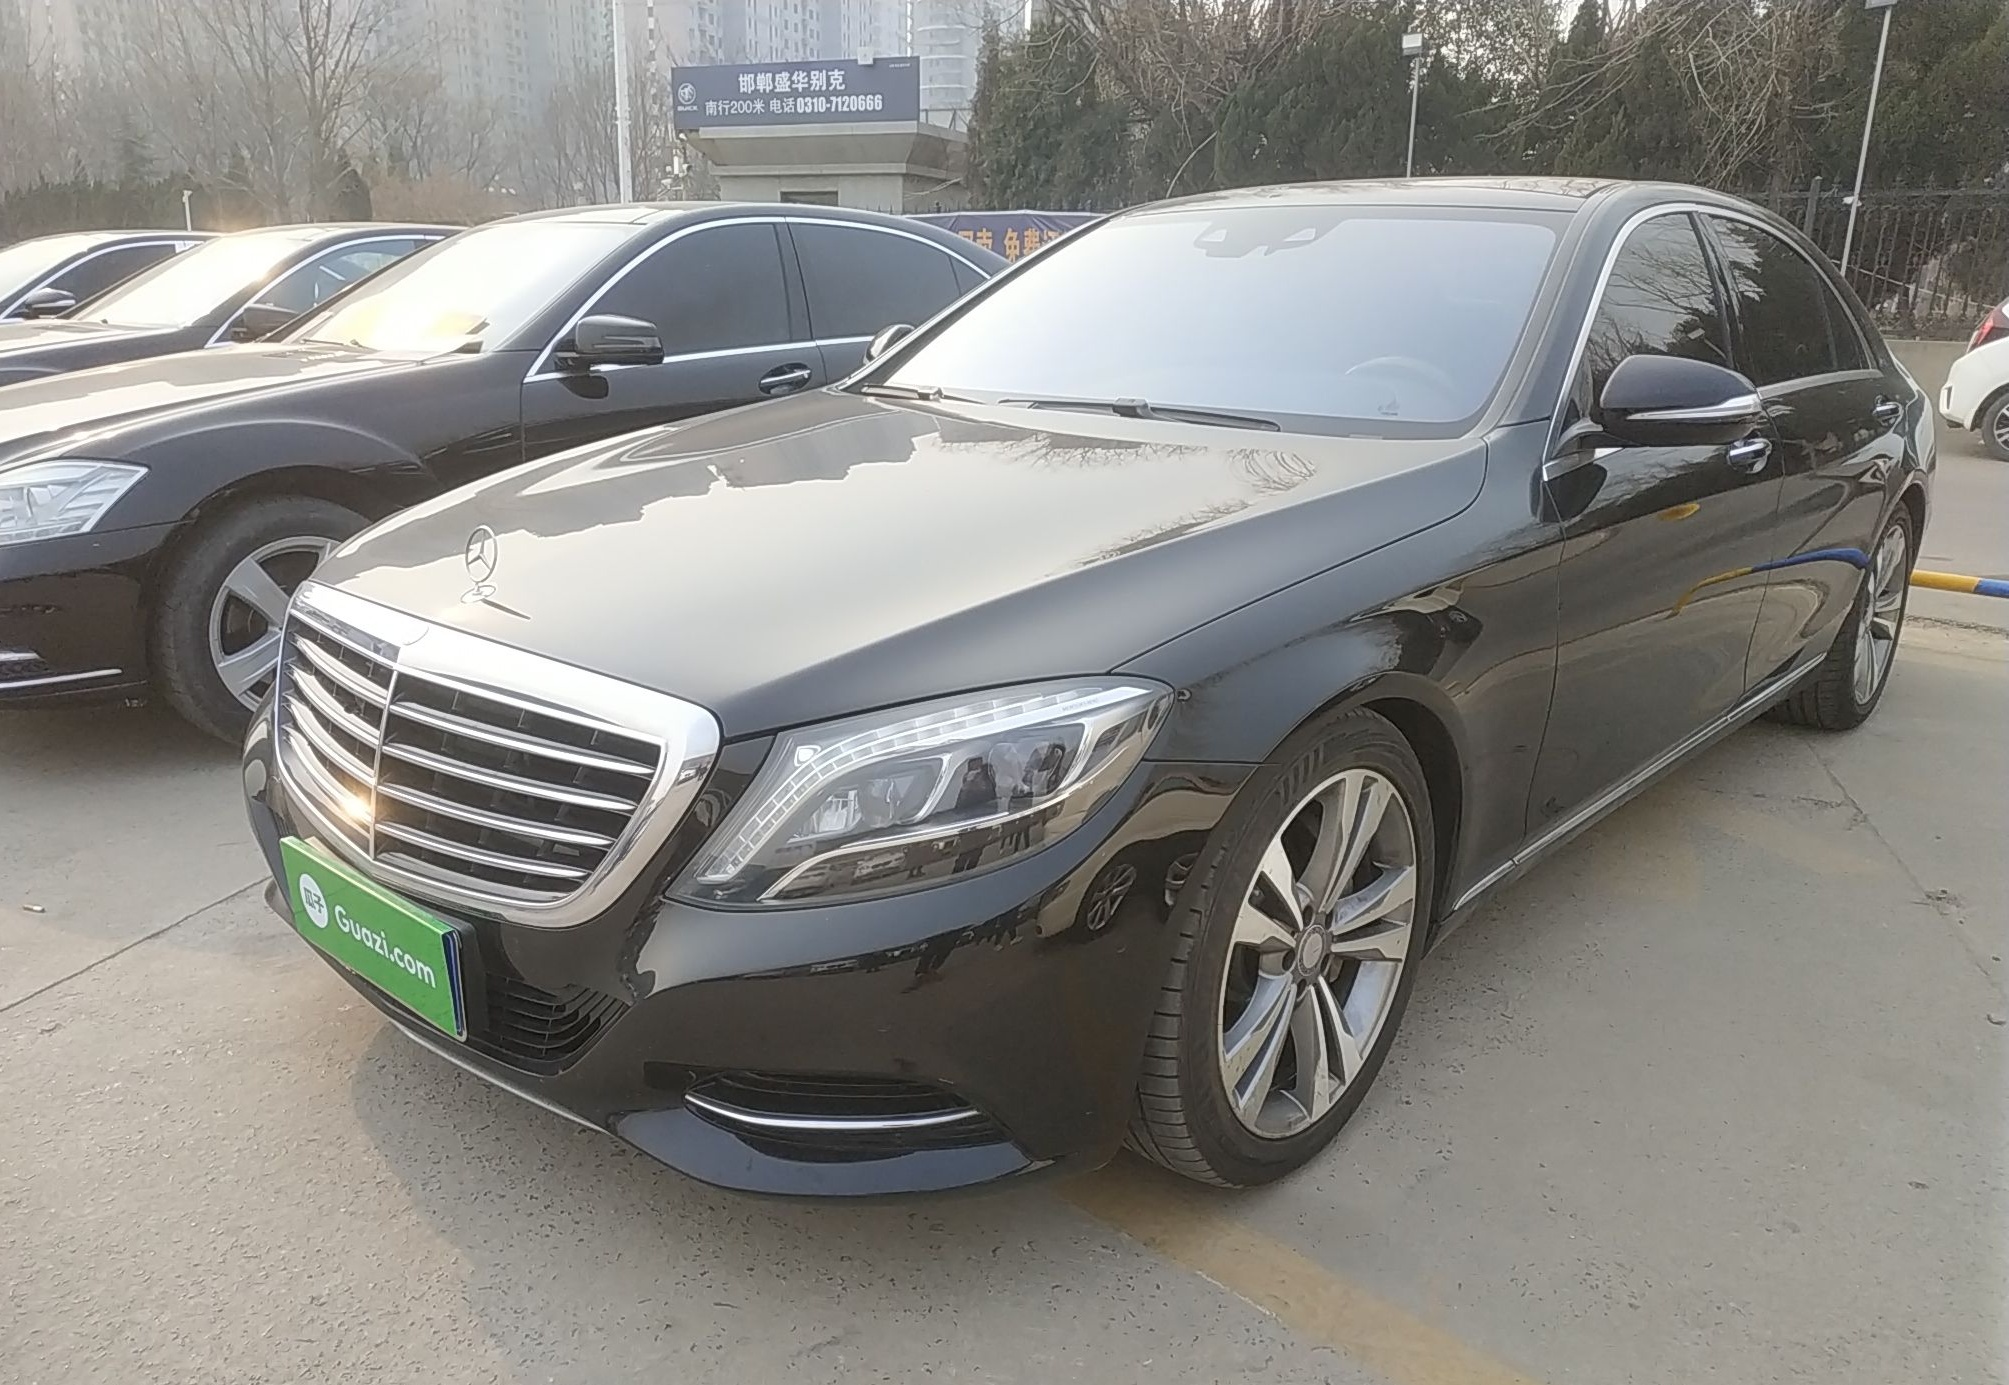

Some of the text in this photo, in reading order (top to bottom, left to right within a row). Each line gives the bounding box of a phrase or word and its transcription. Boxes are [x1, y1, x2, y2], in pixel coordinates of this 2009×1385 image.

[738, 69, 846, 94] 邯郸盛华别克
[705, 98, 765, 116] 南行200米
[303, 886, 325, 914] 瓜子
[334, 904, 437, 989] Guazi.com
